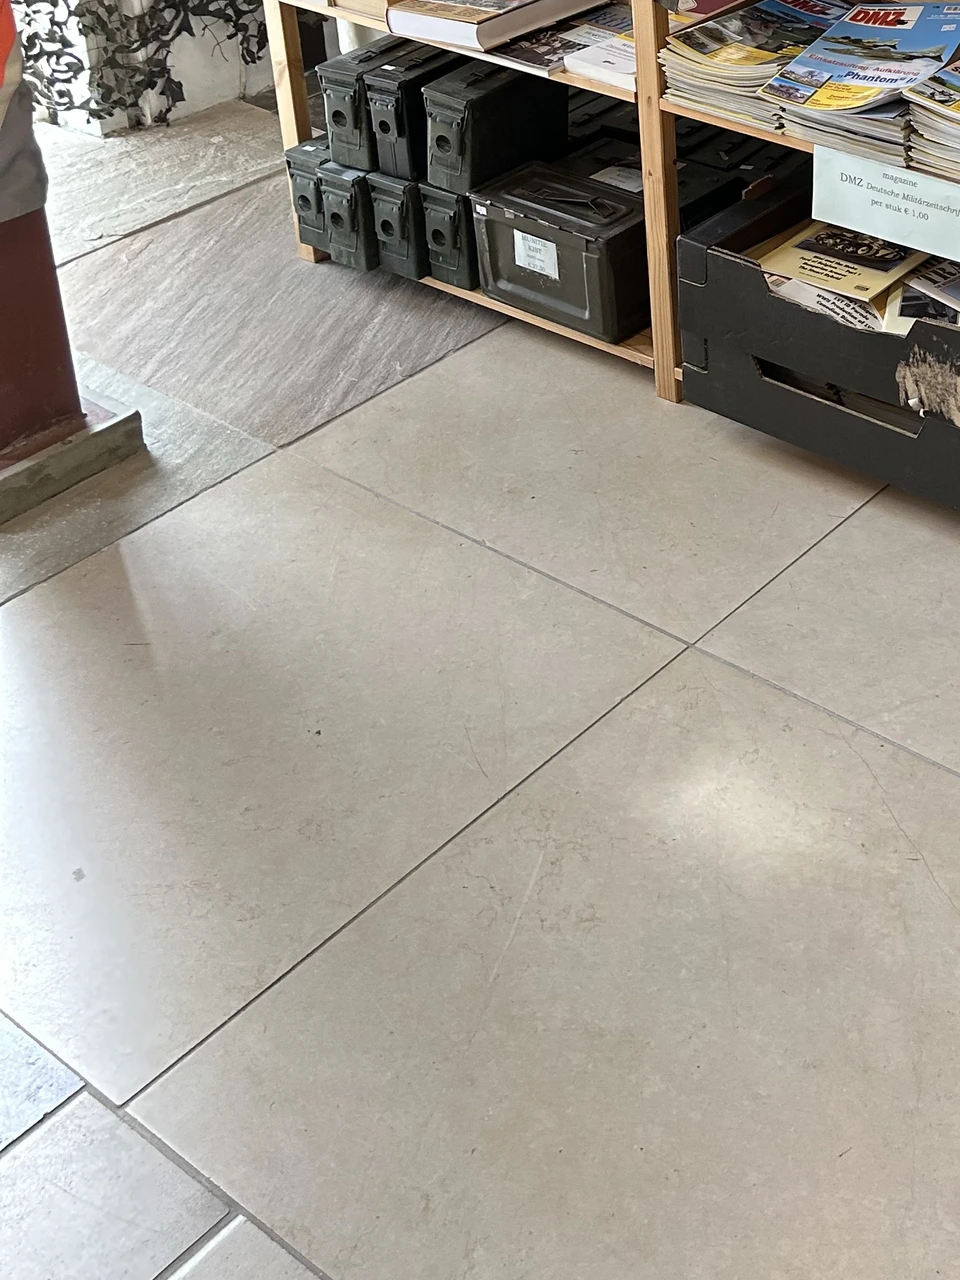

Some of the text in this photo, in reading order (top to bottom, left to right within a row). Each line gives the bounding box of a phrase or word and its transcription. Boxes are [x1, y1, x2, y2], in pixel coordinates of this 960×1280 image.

[849, 9, 907, 27] DMZ
[874, 65, 921, 77] Aufklärung
[840, 172, 864, 188] DMZ
[866, 182, 900, 198] Deutsche
[882, 172, 918, 188] magazine
[870, 198, 883, 208] per
[885, 203, 902, 214] stuk
[911, 209, 929, 221] 1,00
[527, 245, 542, 254] KIST
